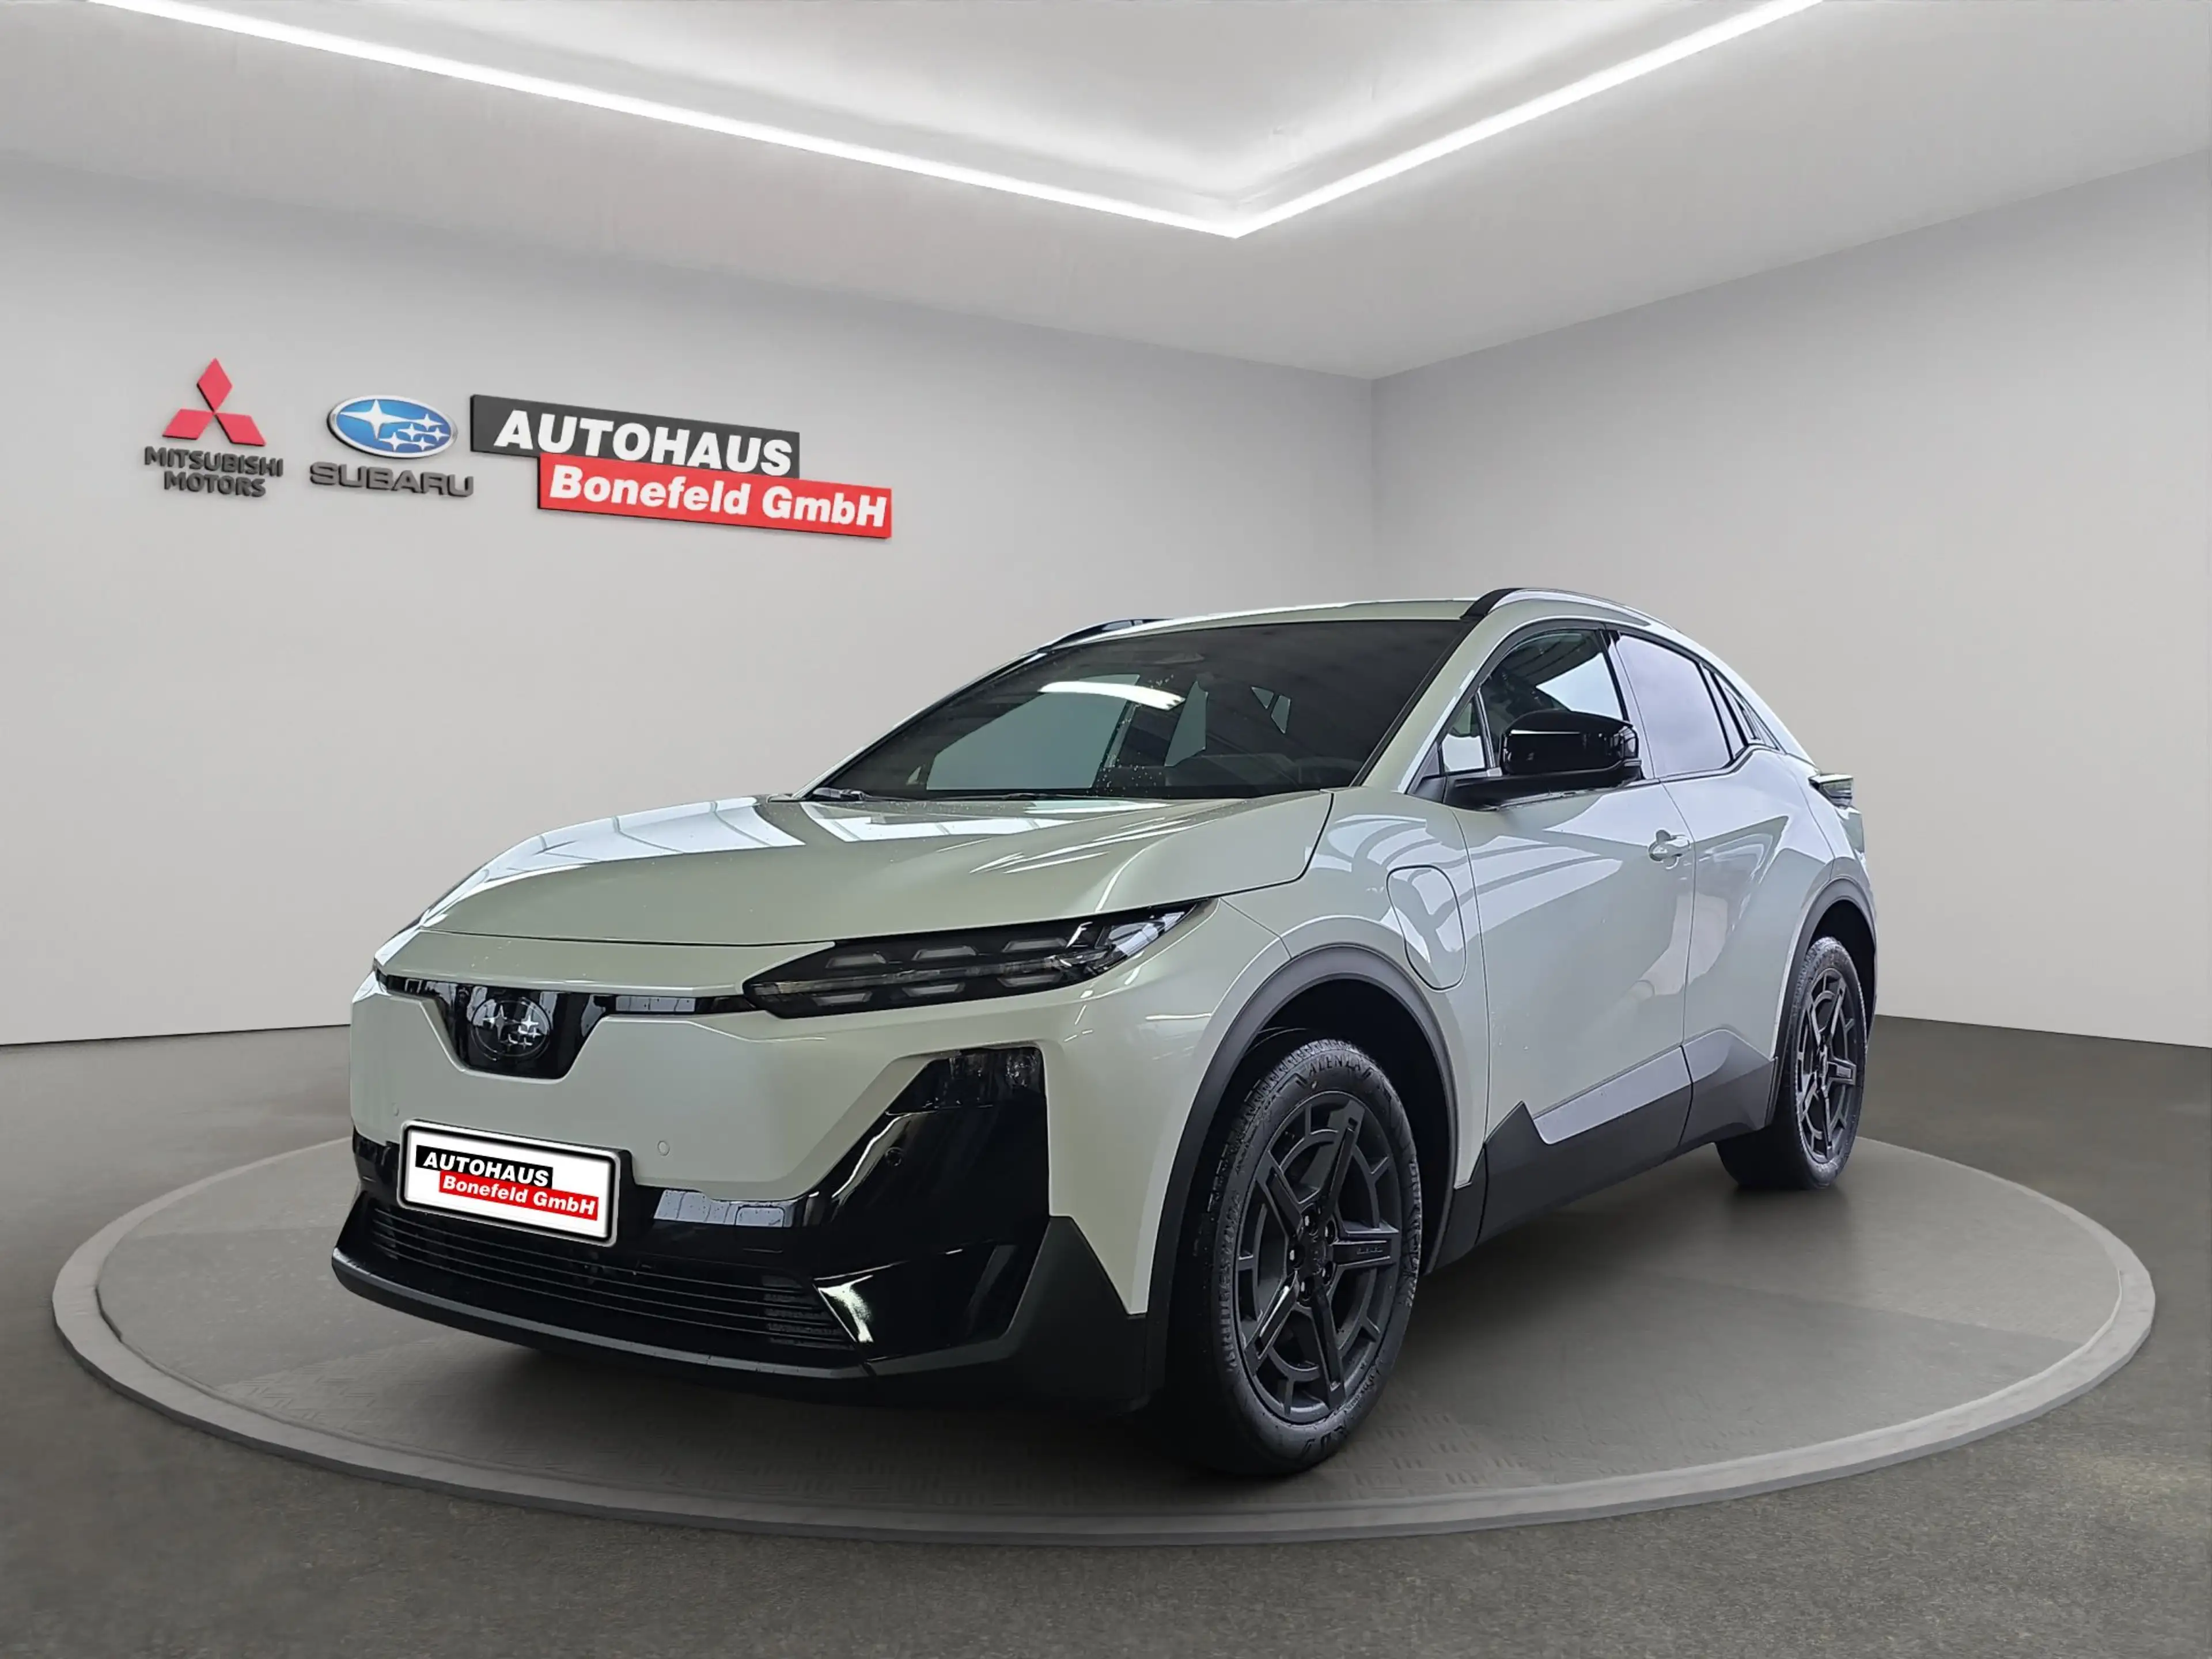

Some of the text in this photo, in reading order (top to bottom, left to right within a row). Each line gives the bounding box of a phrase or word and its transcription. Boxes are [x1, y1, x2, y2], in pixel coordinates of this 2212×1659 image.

[494, 410, 792, 476] AUTOHAUS
[145, 446, 283, 478] MITSUBISHI
[309, 462, 474, 498] SUBARU
[164, 471, 266, 498] MOTORS
[550, 464, 887, 527] Bonefeld GmbH
[423, 1152, 549, 1187] AUTOHAUS
[443, 1175, 596, 1215] Bonefeld GmbH
